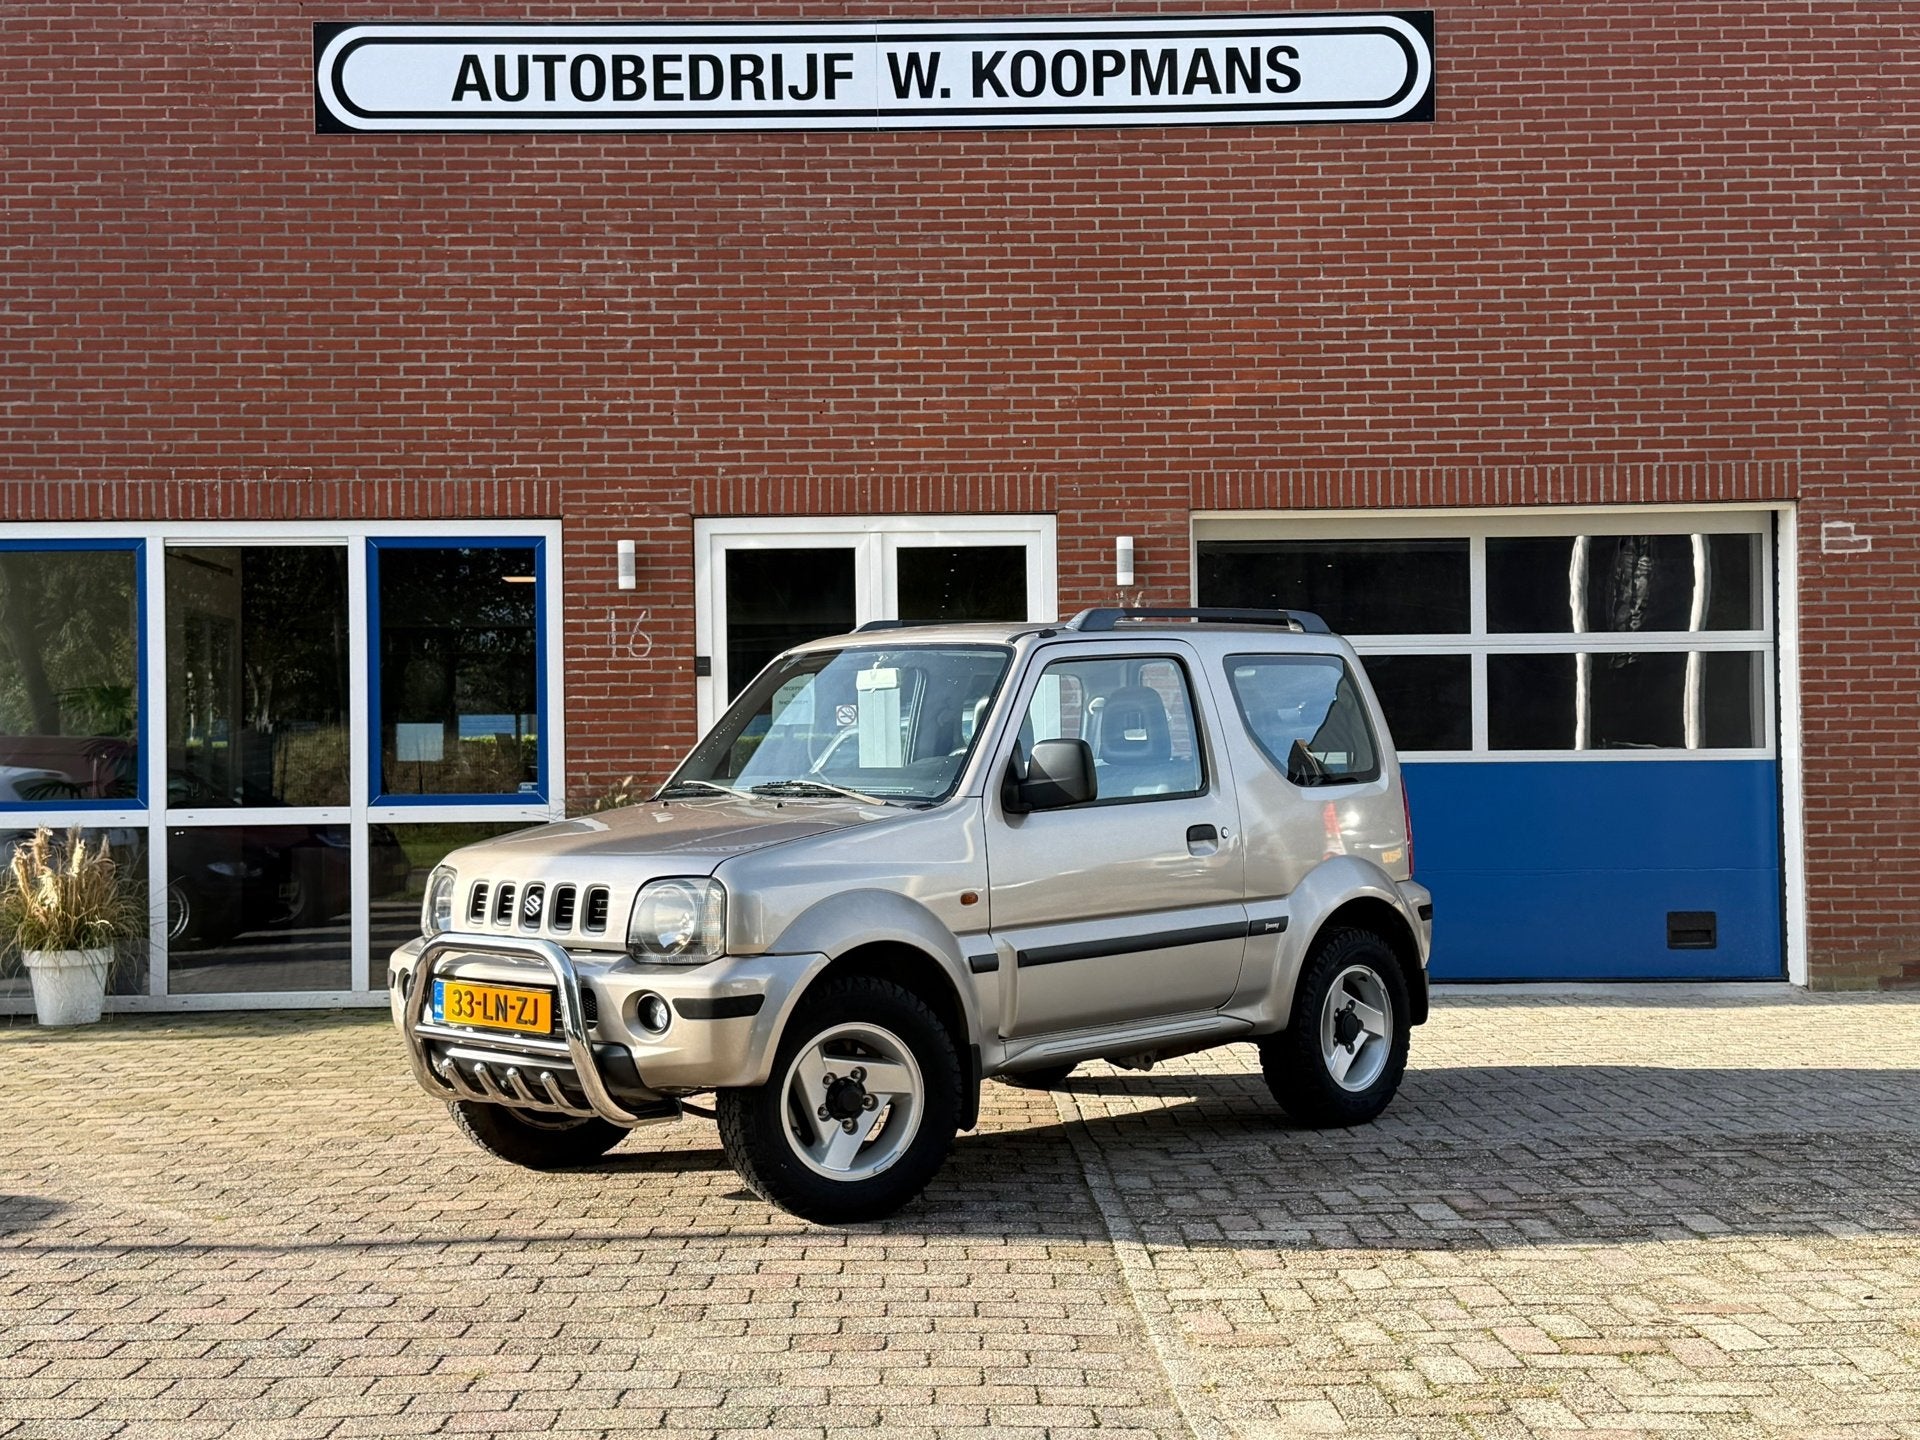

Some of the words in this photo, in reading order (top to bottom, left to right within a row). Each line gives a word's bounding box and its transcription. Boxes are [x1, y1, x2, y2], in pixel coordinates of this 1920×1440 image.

[452, 53, 854, 102] AUTOBEDRIJF
[887, 51, 951, 99] W.
[972, 45, 1301, 98] KOOPMANS
[611, 610, 652, 658] 16
[451, 989, 539, 1026] 33-LN-ZJ
